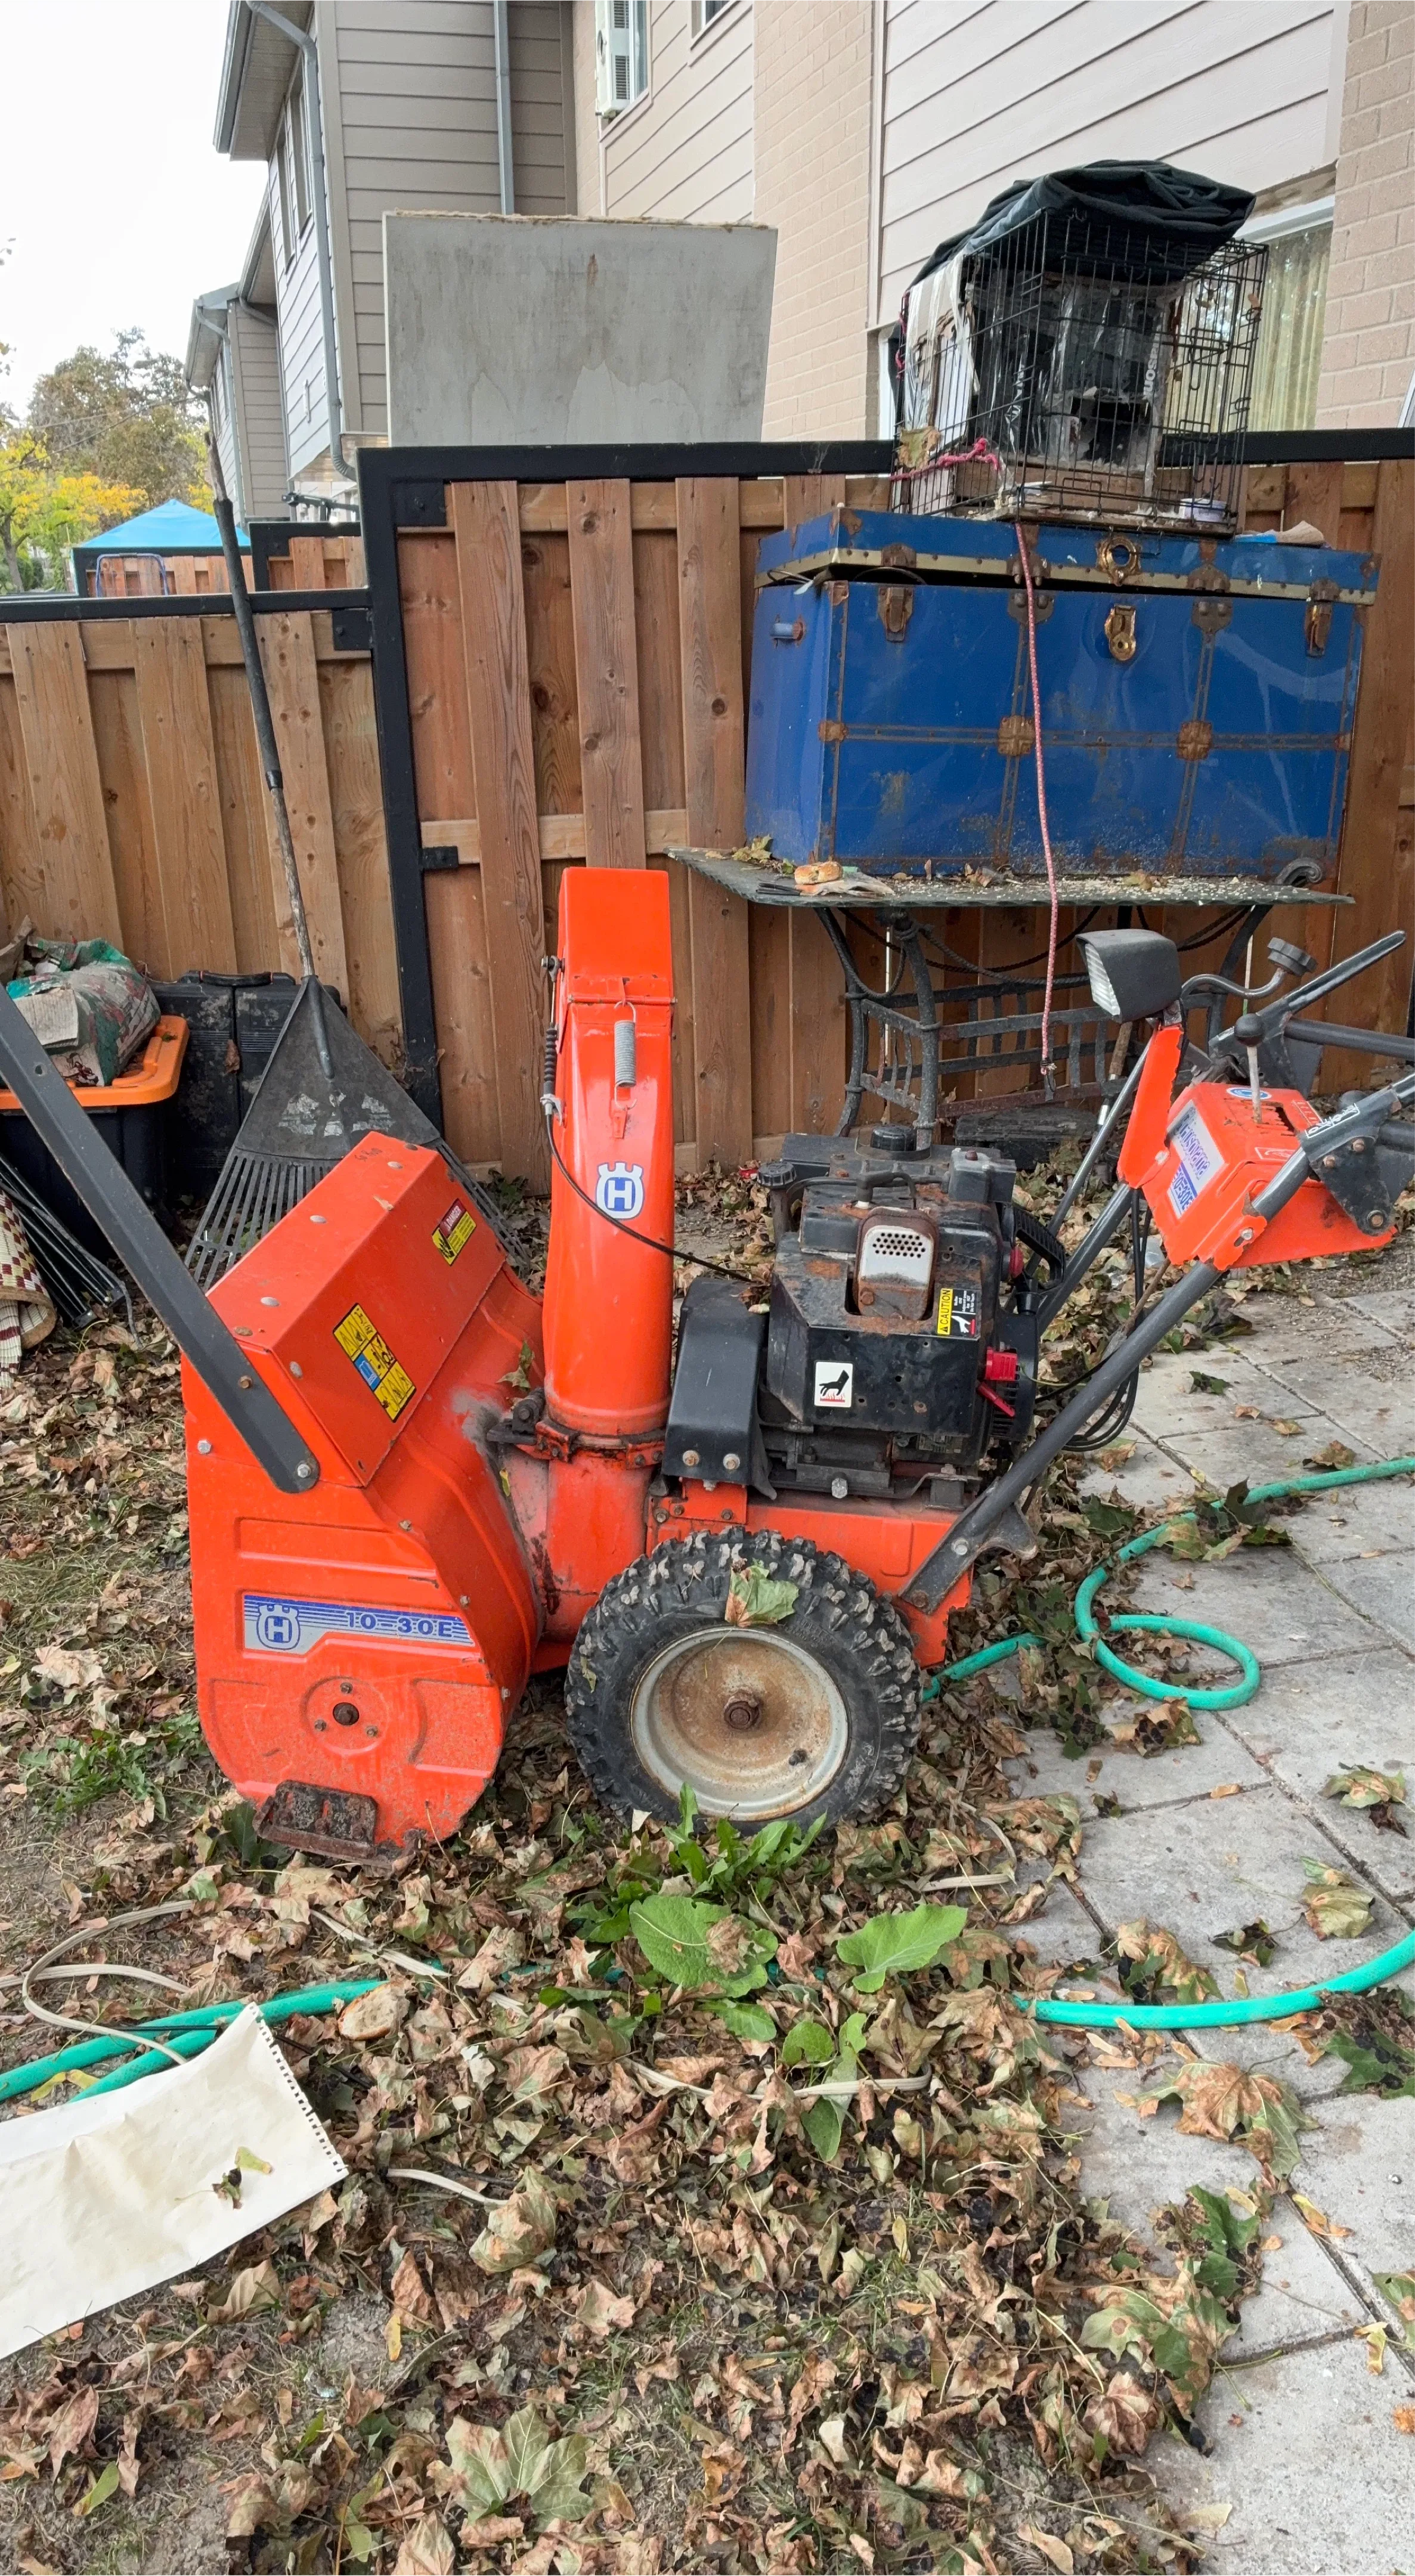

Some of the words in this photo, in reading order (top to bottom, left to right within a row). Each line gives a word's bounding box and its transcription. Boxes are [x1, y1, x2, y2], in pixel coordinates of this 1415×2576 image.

[1173, 1172, 1193, 1210] 10-30E
[446, 1205, 462, 1227] DANGER
[940, 1289, 950, 1325] CAUTION
[347, 1611, 453, 1638] 10-30E
